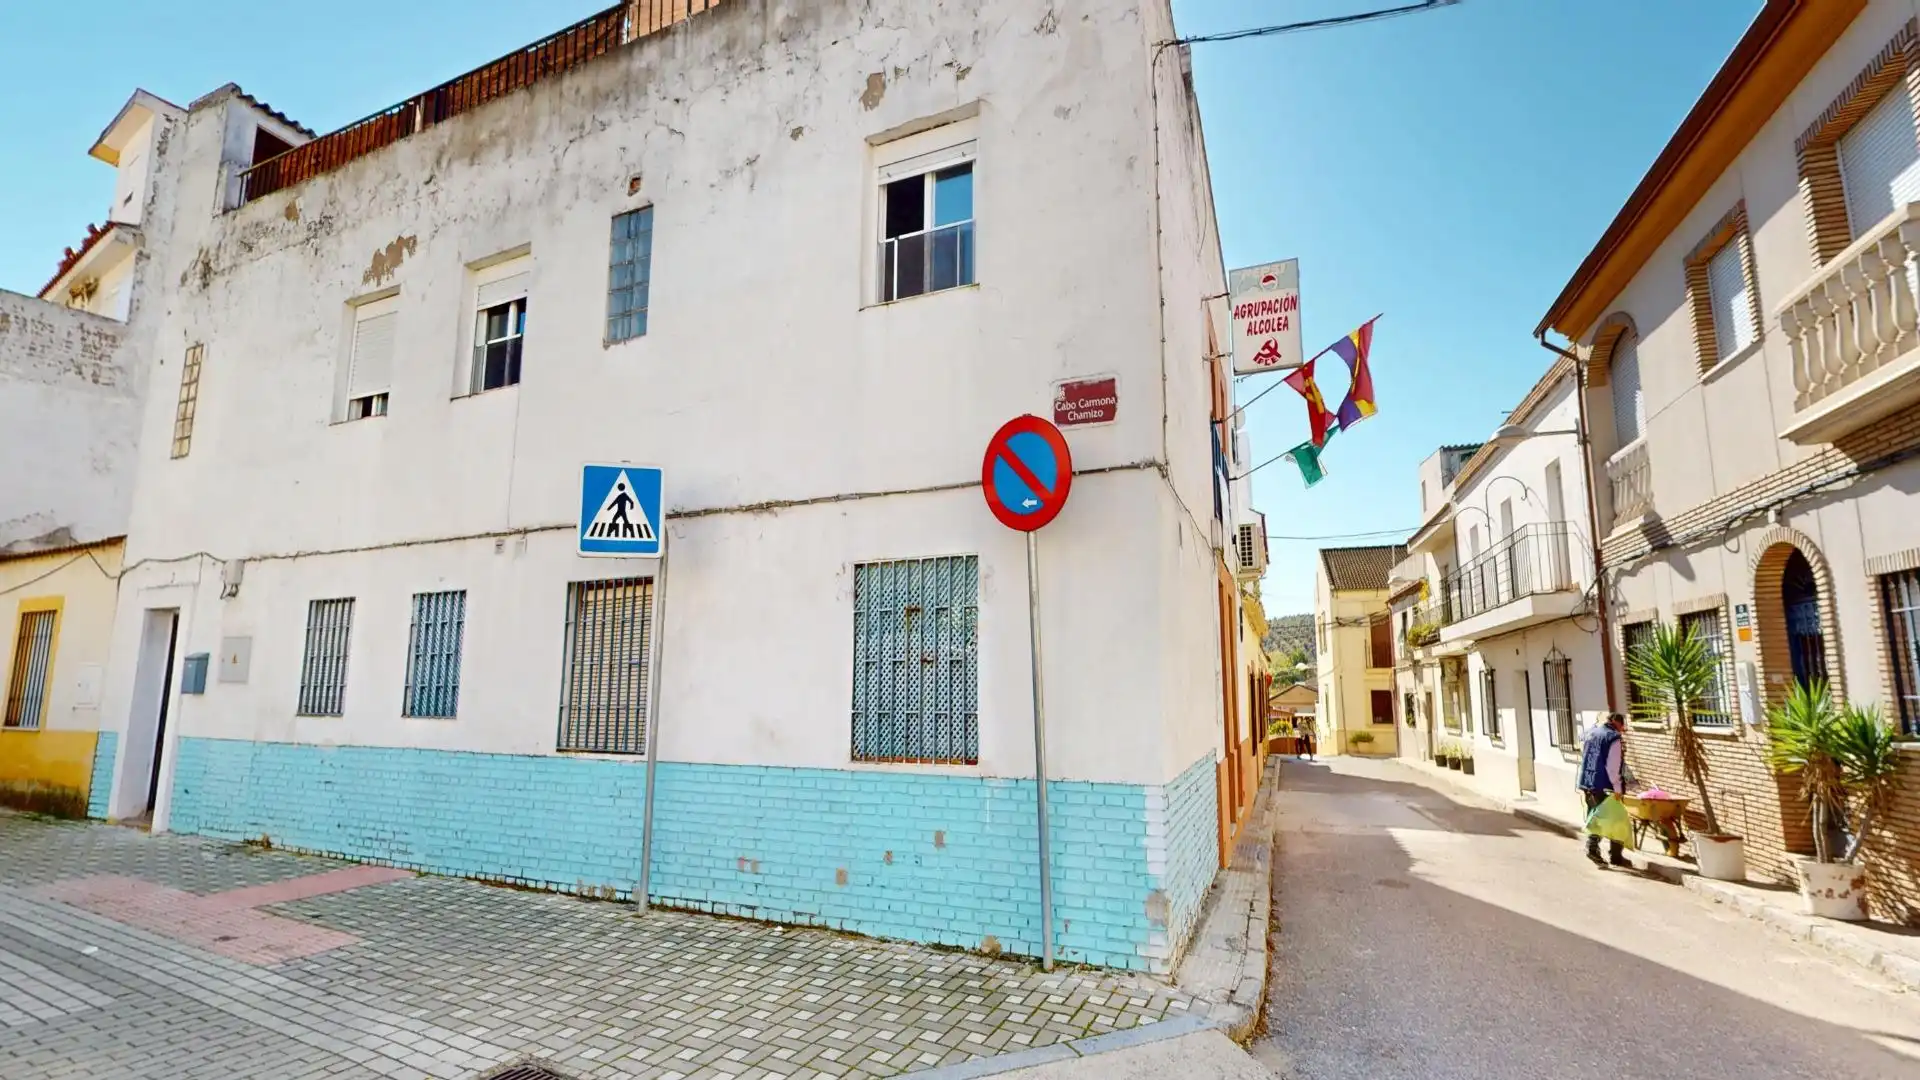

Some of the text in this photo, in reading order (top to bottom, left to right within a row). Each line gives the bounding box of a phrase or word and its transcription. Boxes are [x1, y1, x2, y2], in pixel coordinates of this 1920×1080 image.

[1234, 292, 1298, 320] AGRUPACIÓN
[1246, 315, 1289, 337] ALCOLEA
[1055, 397, 1116, 411] Cabo Carmona
[1067, 409, 1104, 421] Chamizo
